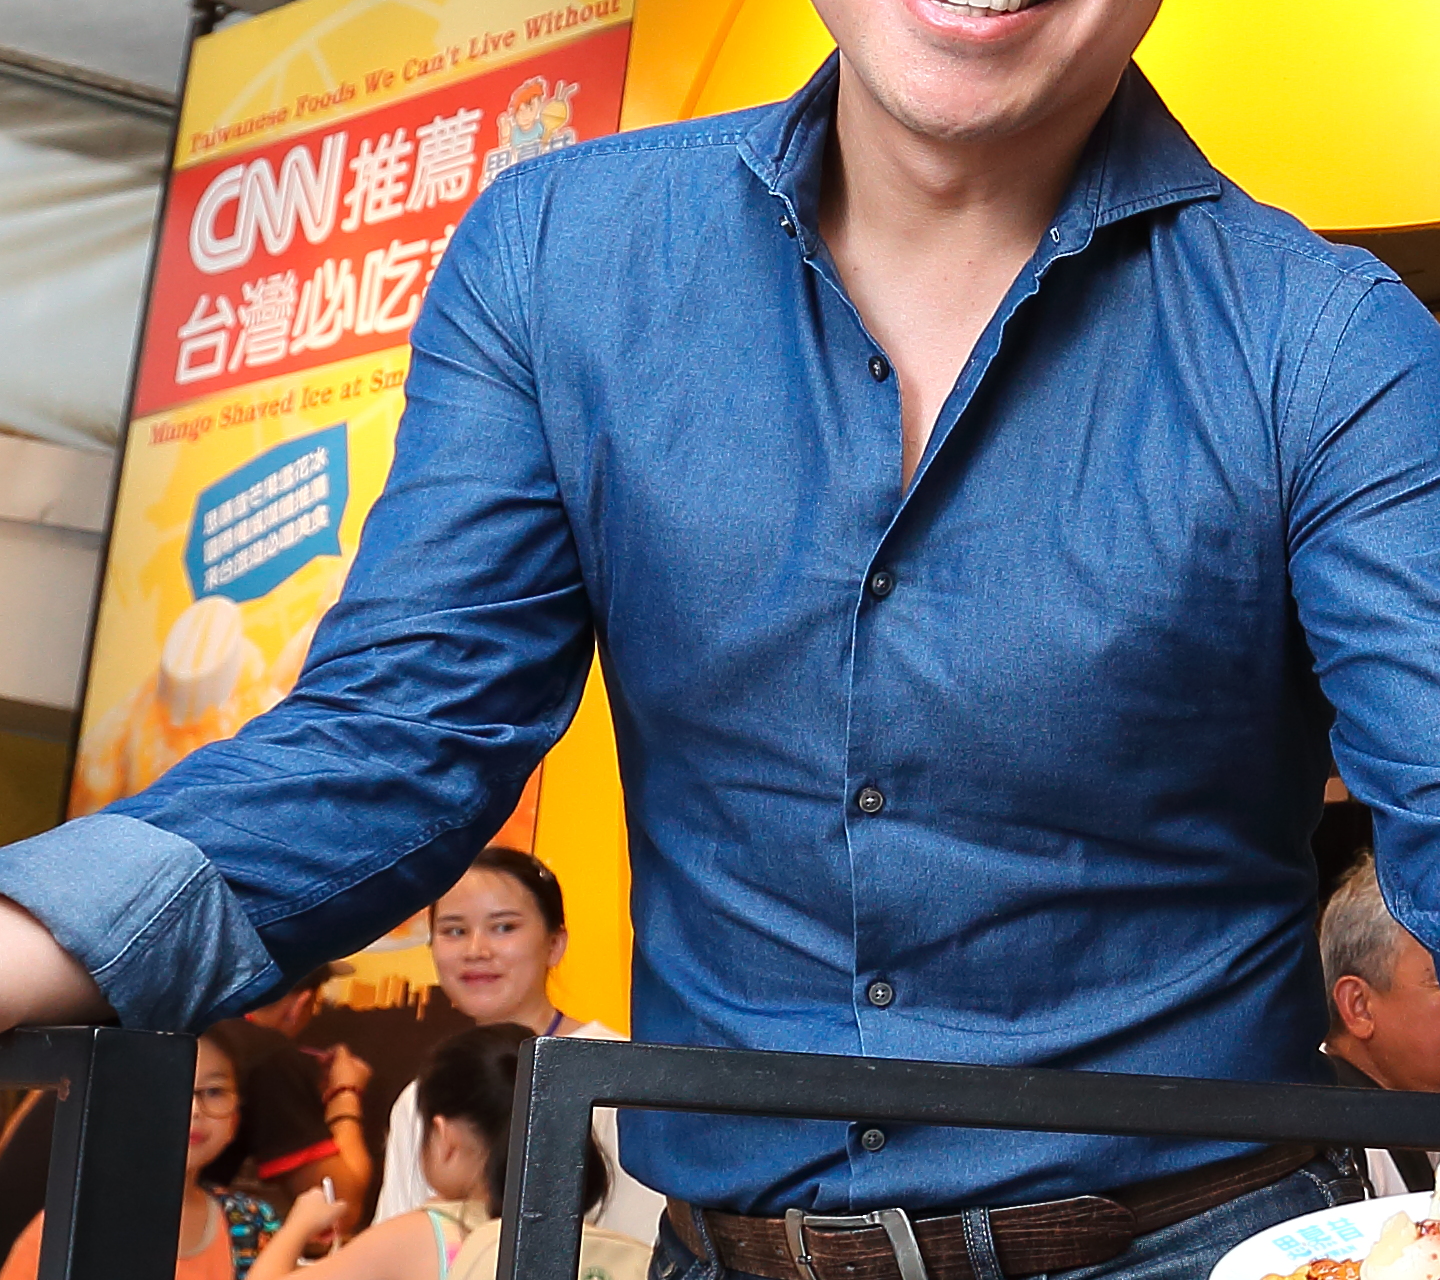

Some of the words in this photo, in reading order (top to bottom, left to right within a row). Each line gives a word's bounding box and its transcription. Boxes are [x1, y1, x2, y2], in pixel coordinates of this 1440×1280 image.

[189, 106, 288, 154] Taiwanese
[296, 84, 356, 119] Foods
[364, 68, 395, 95] We
[403, 44, 461, 84] Can't
[468, 27, 515, 60] Live
[149, 413, 214, 446] Mango
[218, 389, 293, 430] Shaved
[300, 384, 334, 408] Ice
[341, 381, 361, 400] at
[1271, 1217, 1365, 1261] 思慕昔
